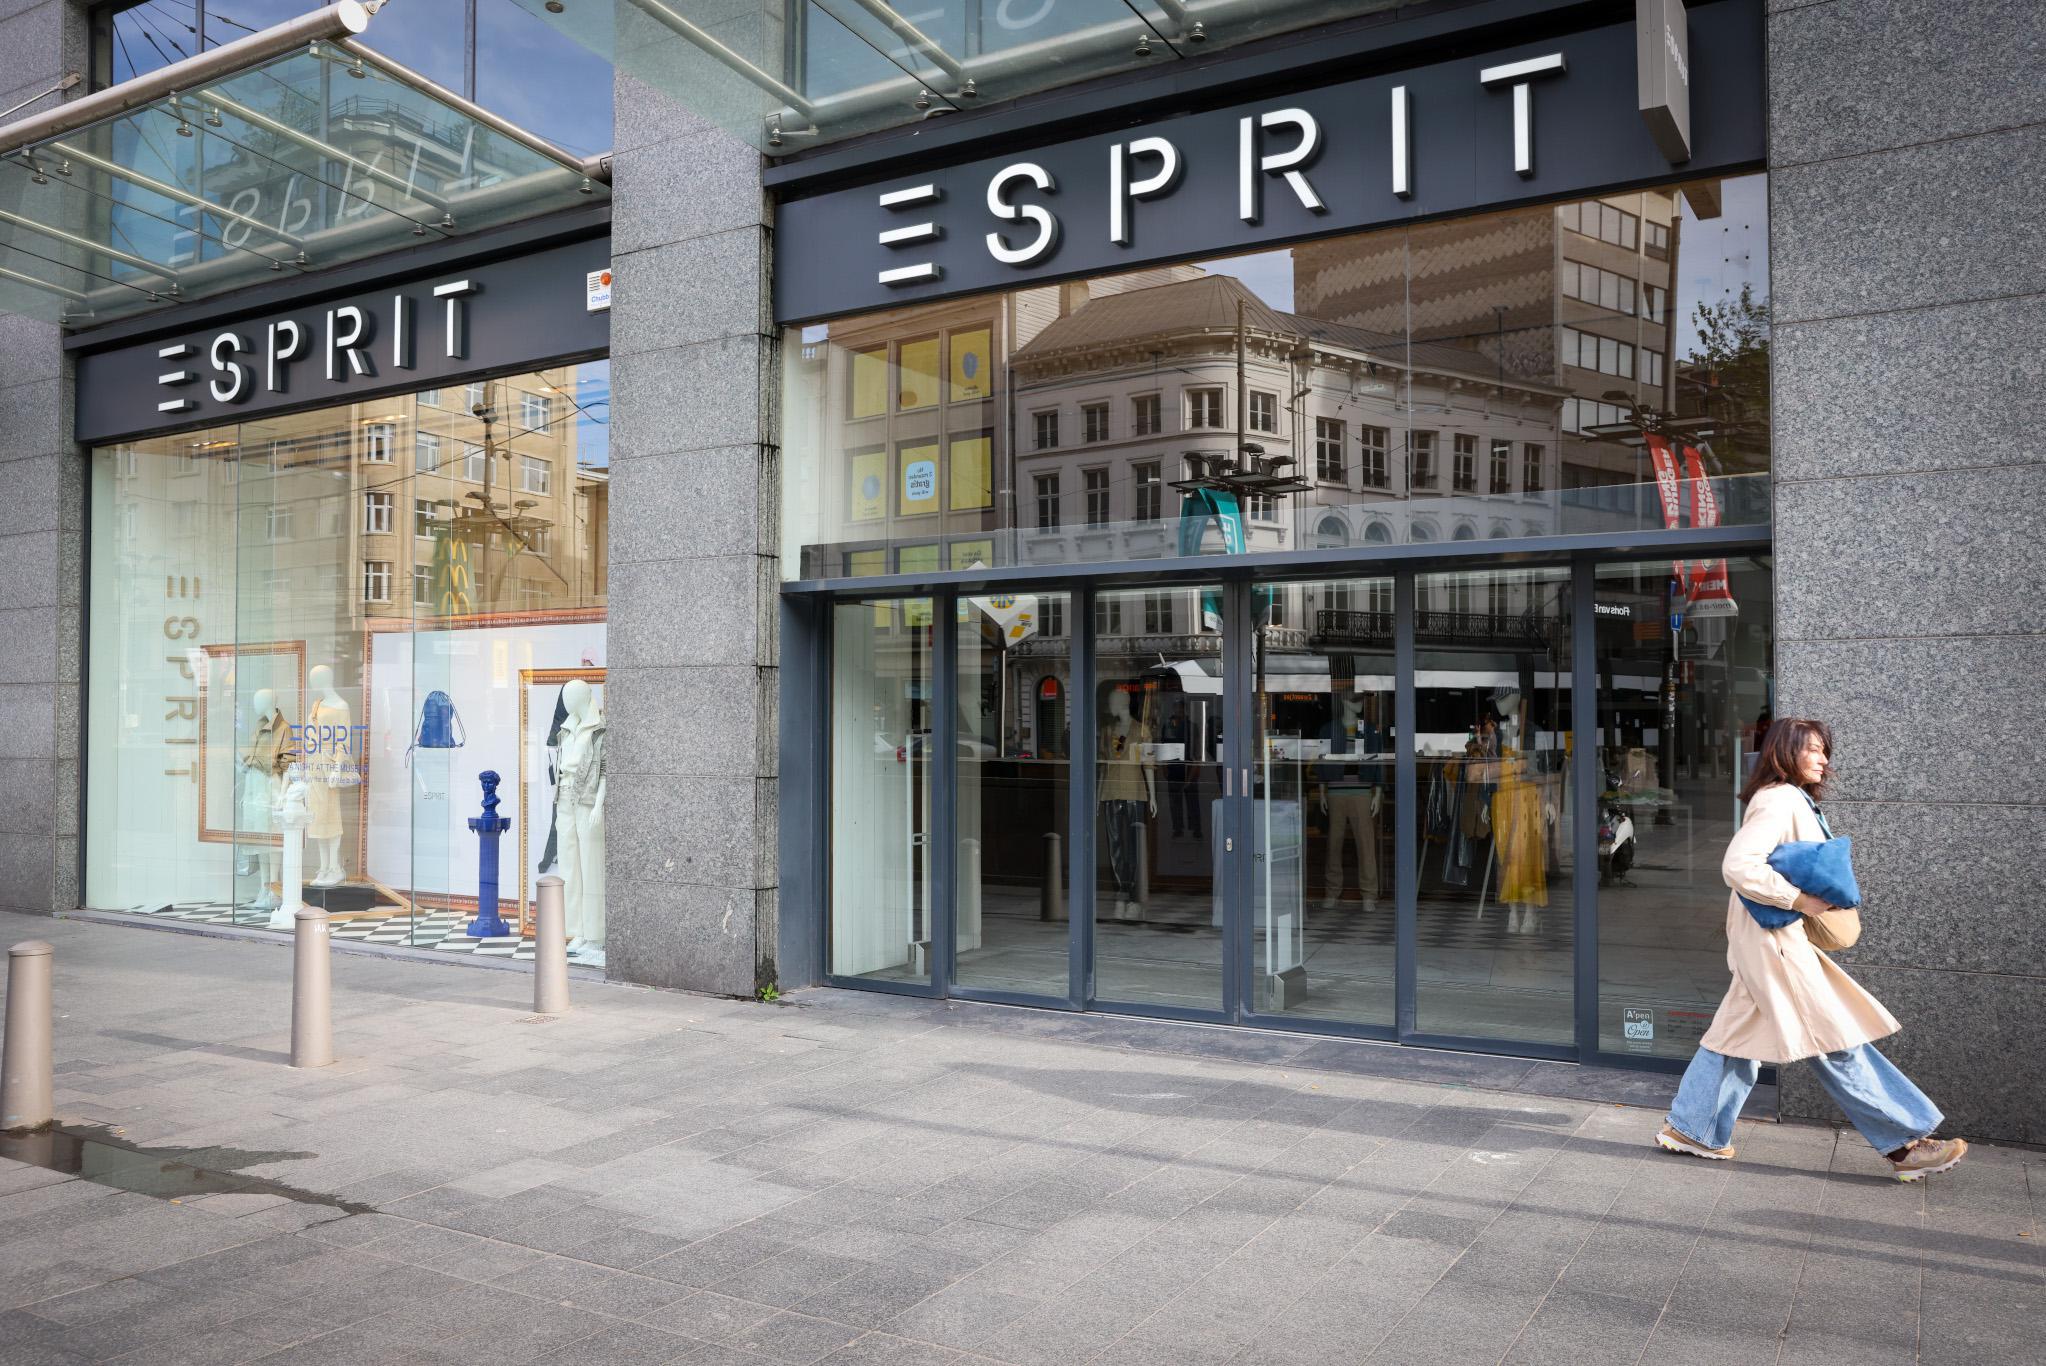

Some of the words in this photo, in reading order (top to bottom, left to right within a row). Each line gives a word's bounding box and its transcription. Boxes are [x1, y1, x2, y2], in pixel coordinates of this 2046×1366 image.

[879, 52, 1567, 287] ESPRIT
[591, 293, 610, 303] Chubb
[158, 279, 476, 412] ESPRIT
[163, 575, 200, 784] ESPRIT
[288, 725, 369, 755] ESPRIT
[424, 791, 446, 800] ESPRIT
[1627, 1024, 1650, 1037] Open
